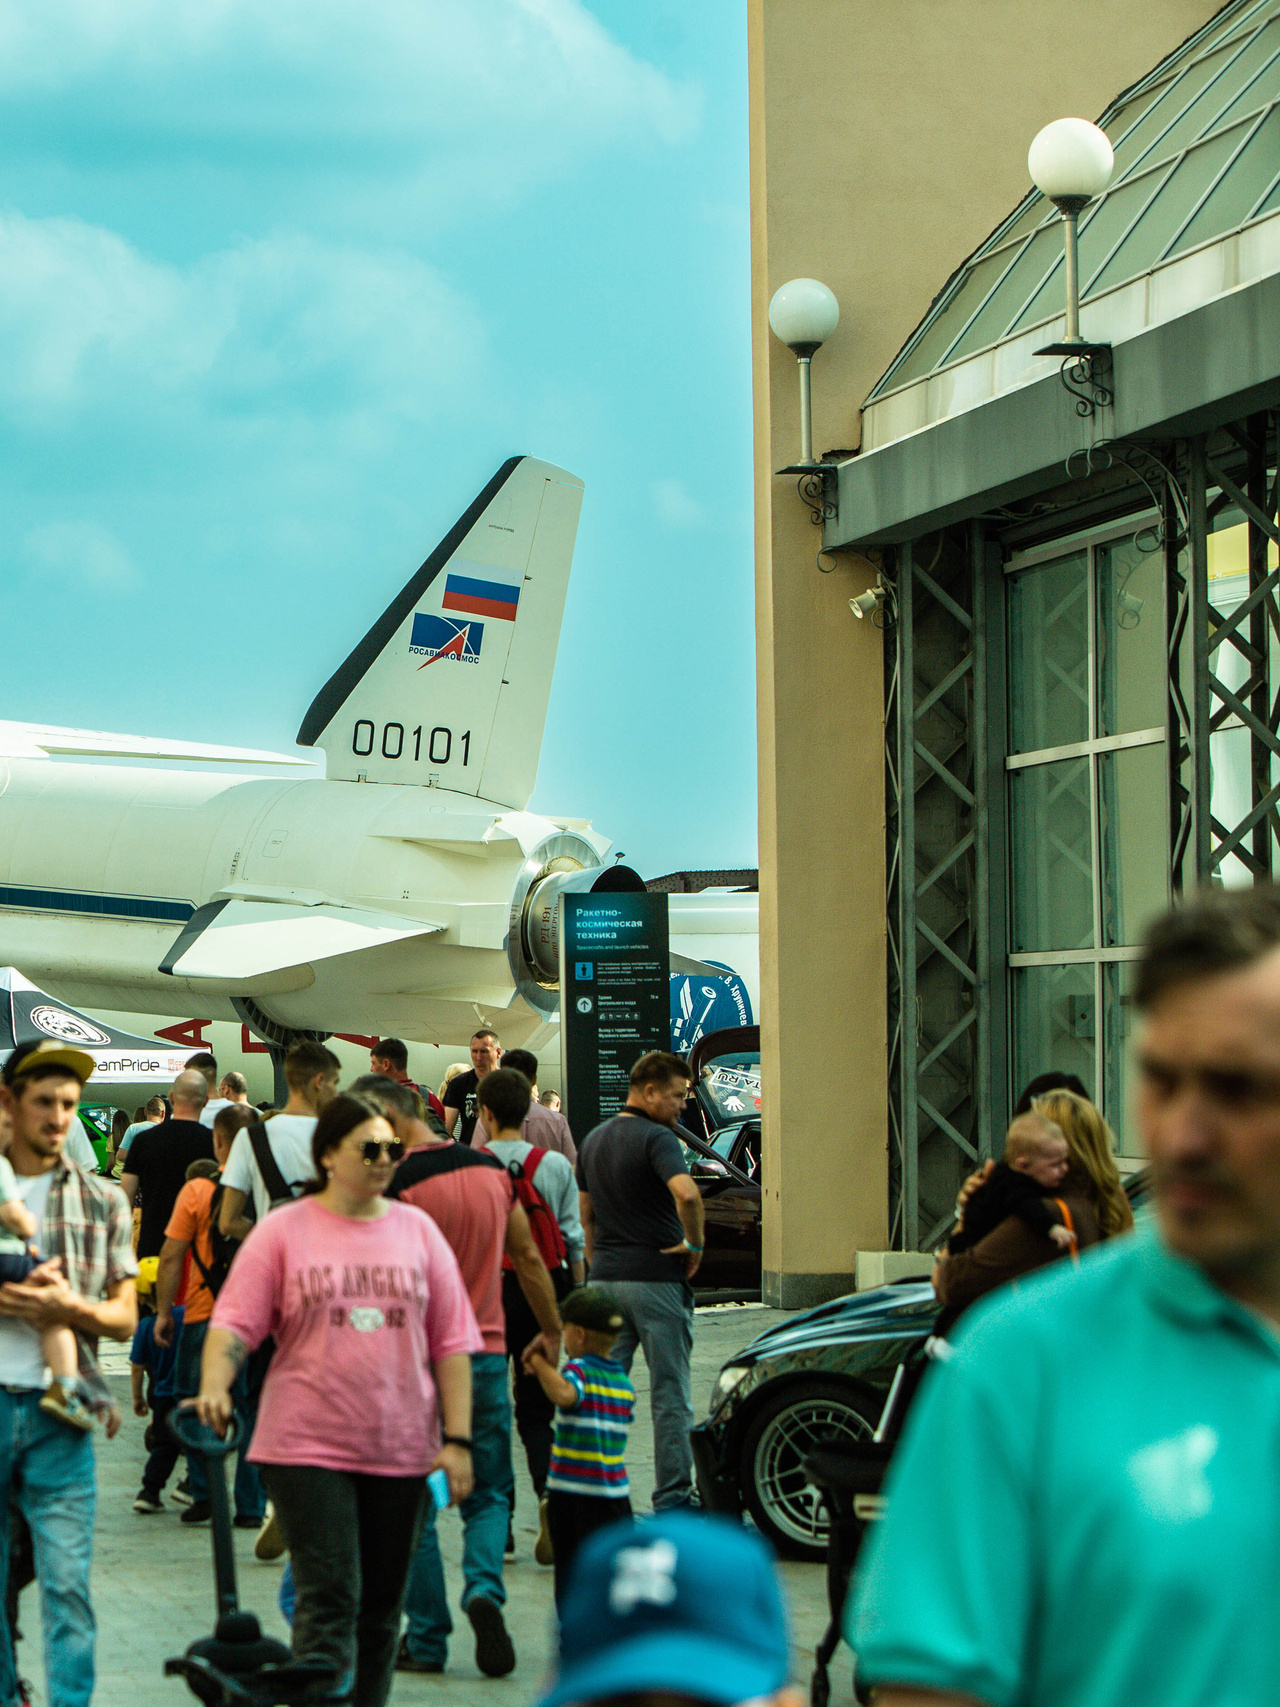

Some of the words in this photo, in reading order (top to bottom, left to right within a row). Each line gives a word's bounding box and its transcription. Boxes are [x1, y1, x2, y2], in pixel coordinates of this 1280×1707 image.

[408, 646, 480, 664] РОСАВИАКОСМОС
[352, 719, 471, 766] 00101
[576, 908, 622, 917] Ракетно-
[576, 920, 643, 928] космическая
[576, 931, 617, 939] техника
[298, 1266, 336, 1307] LOS
[342, 1263, 424, 1308] ANGELE
